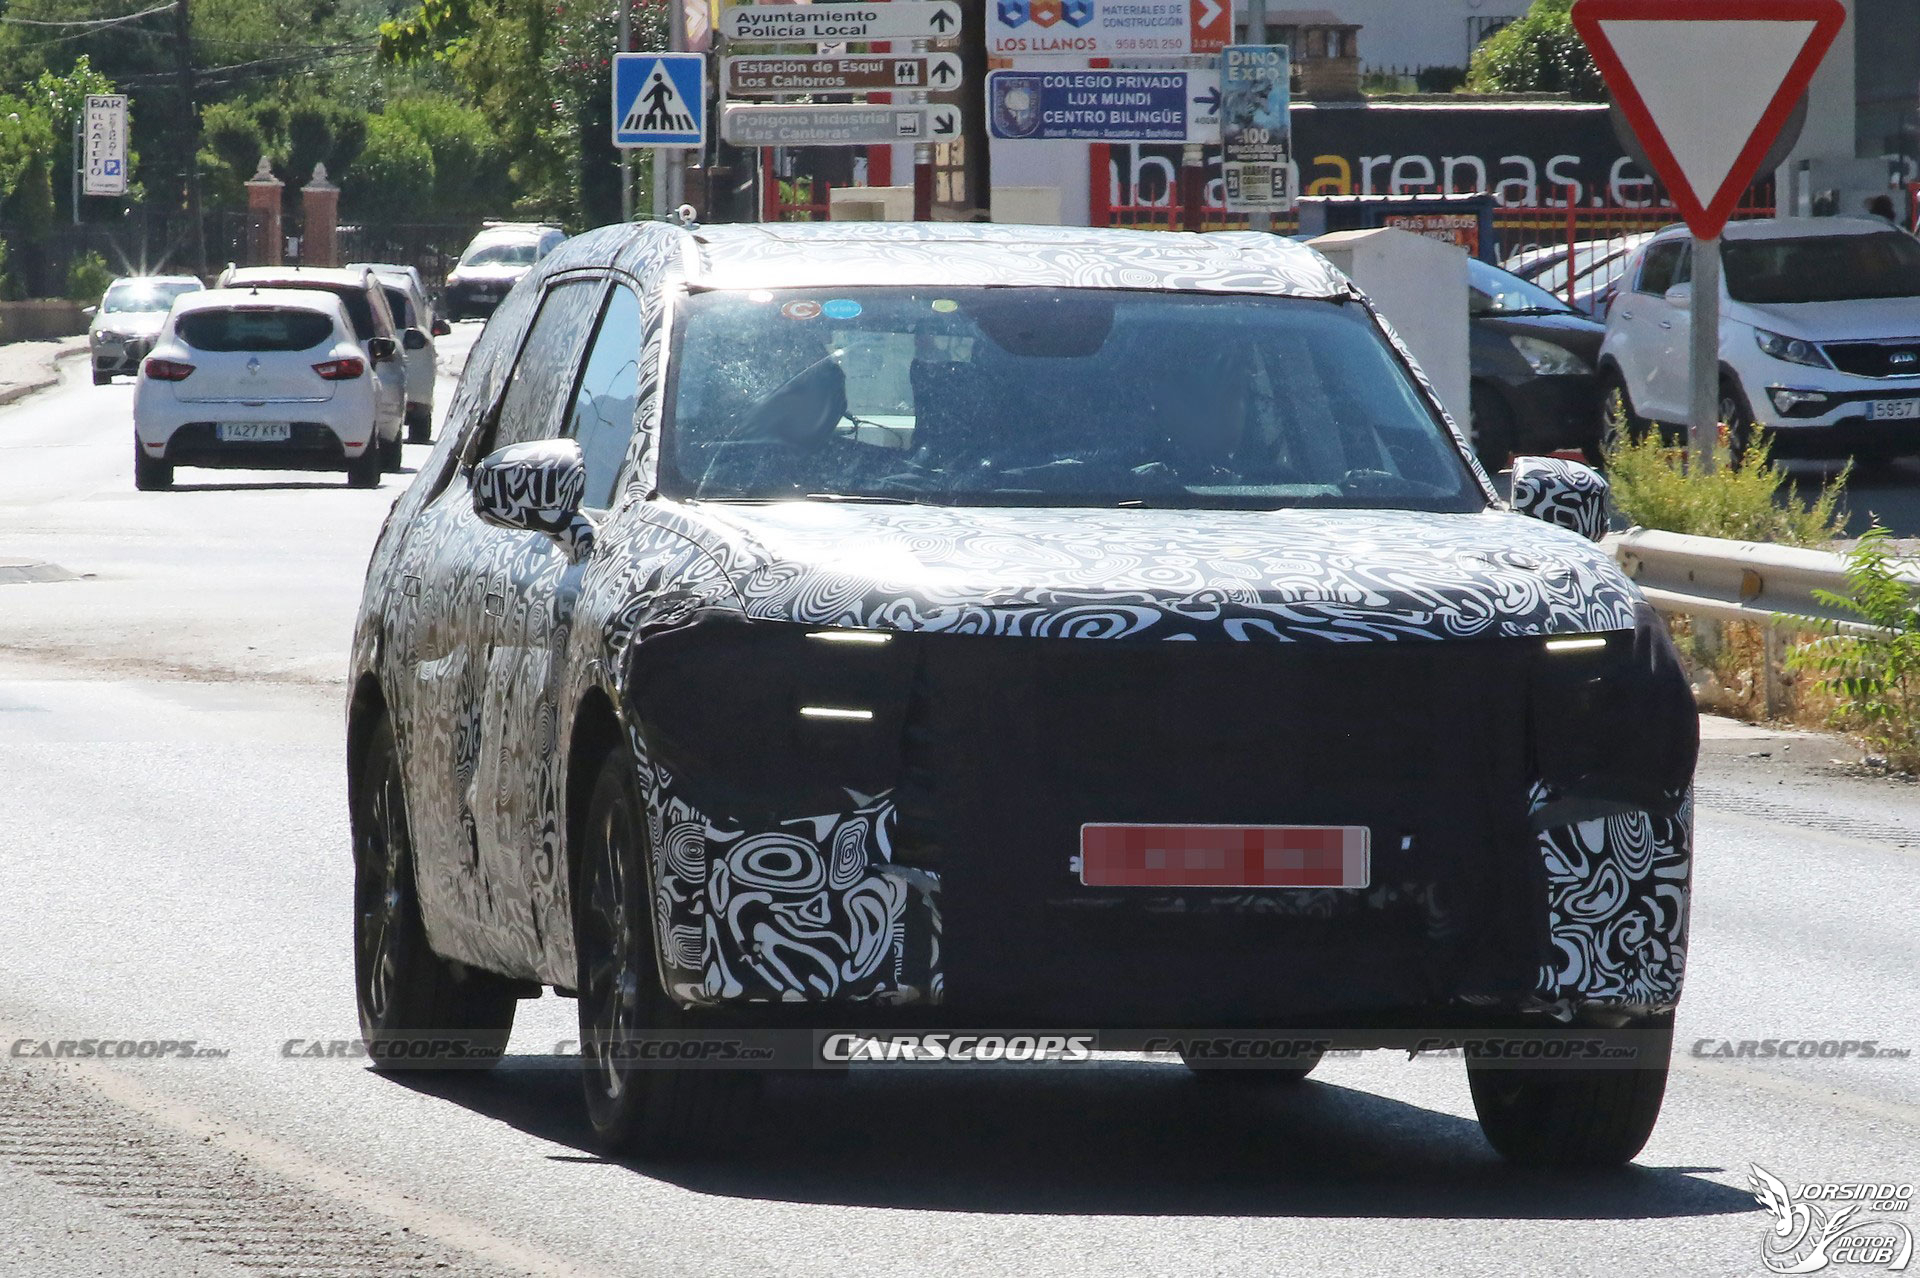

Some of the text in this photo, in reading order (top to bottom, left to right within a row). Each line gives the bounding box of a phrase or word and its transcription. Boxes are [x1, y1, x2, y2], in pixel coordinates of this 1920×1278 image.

[1102, 5, 1182, 15] MATERIALES DE
[736, 11, 877, 25] Ayuntamiento
[738, 24, 867, 37] Policía Local
[996, 37, 1097, 51] LOS LLANOS
[1229, 51, 1279, 65] DINO
[738, 60, 884, 74] Estación de Esquí
[1229, 67, 1279, 80] EXPO
[738, 75, 846, 87] Los Cahorros
[1043, 76, 1112, 88] COLEGIO
[1116, 76, 1183, 88] PRIVADO
[91, 99, 121, 108] BAR
[1068, 93, 1151, 105] LUX MUNDI
[814, 113, 890, 125] Industrial
[1043, 109, 1182, 123] CENTRO BILINGÜE
[228, 425, 258, 438] 1427
